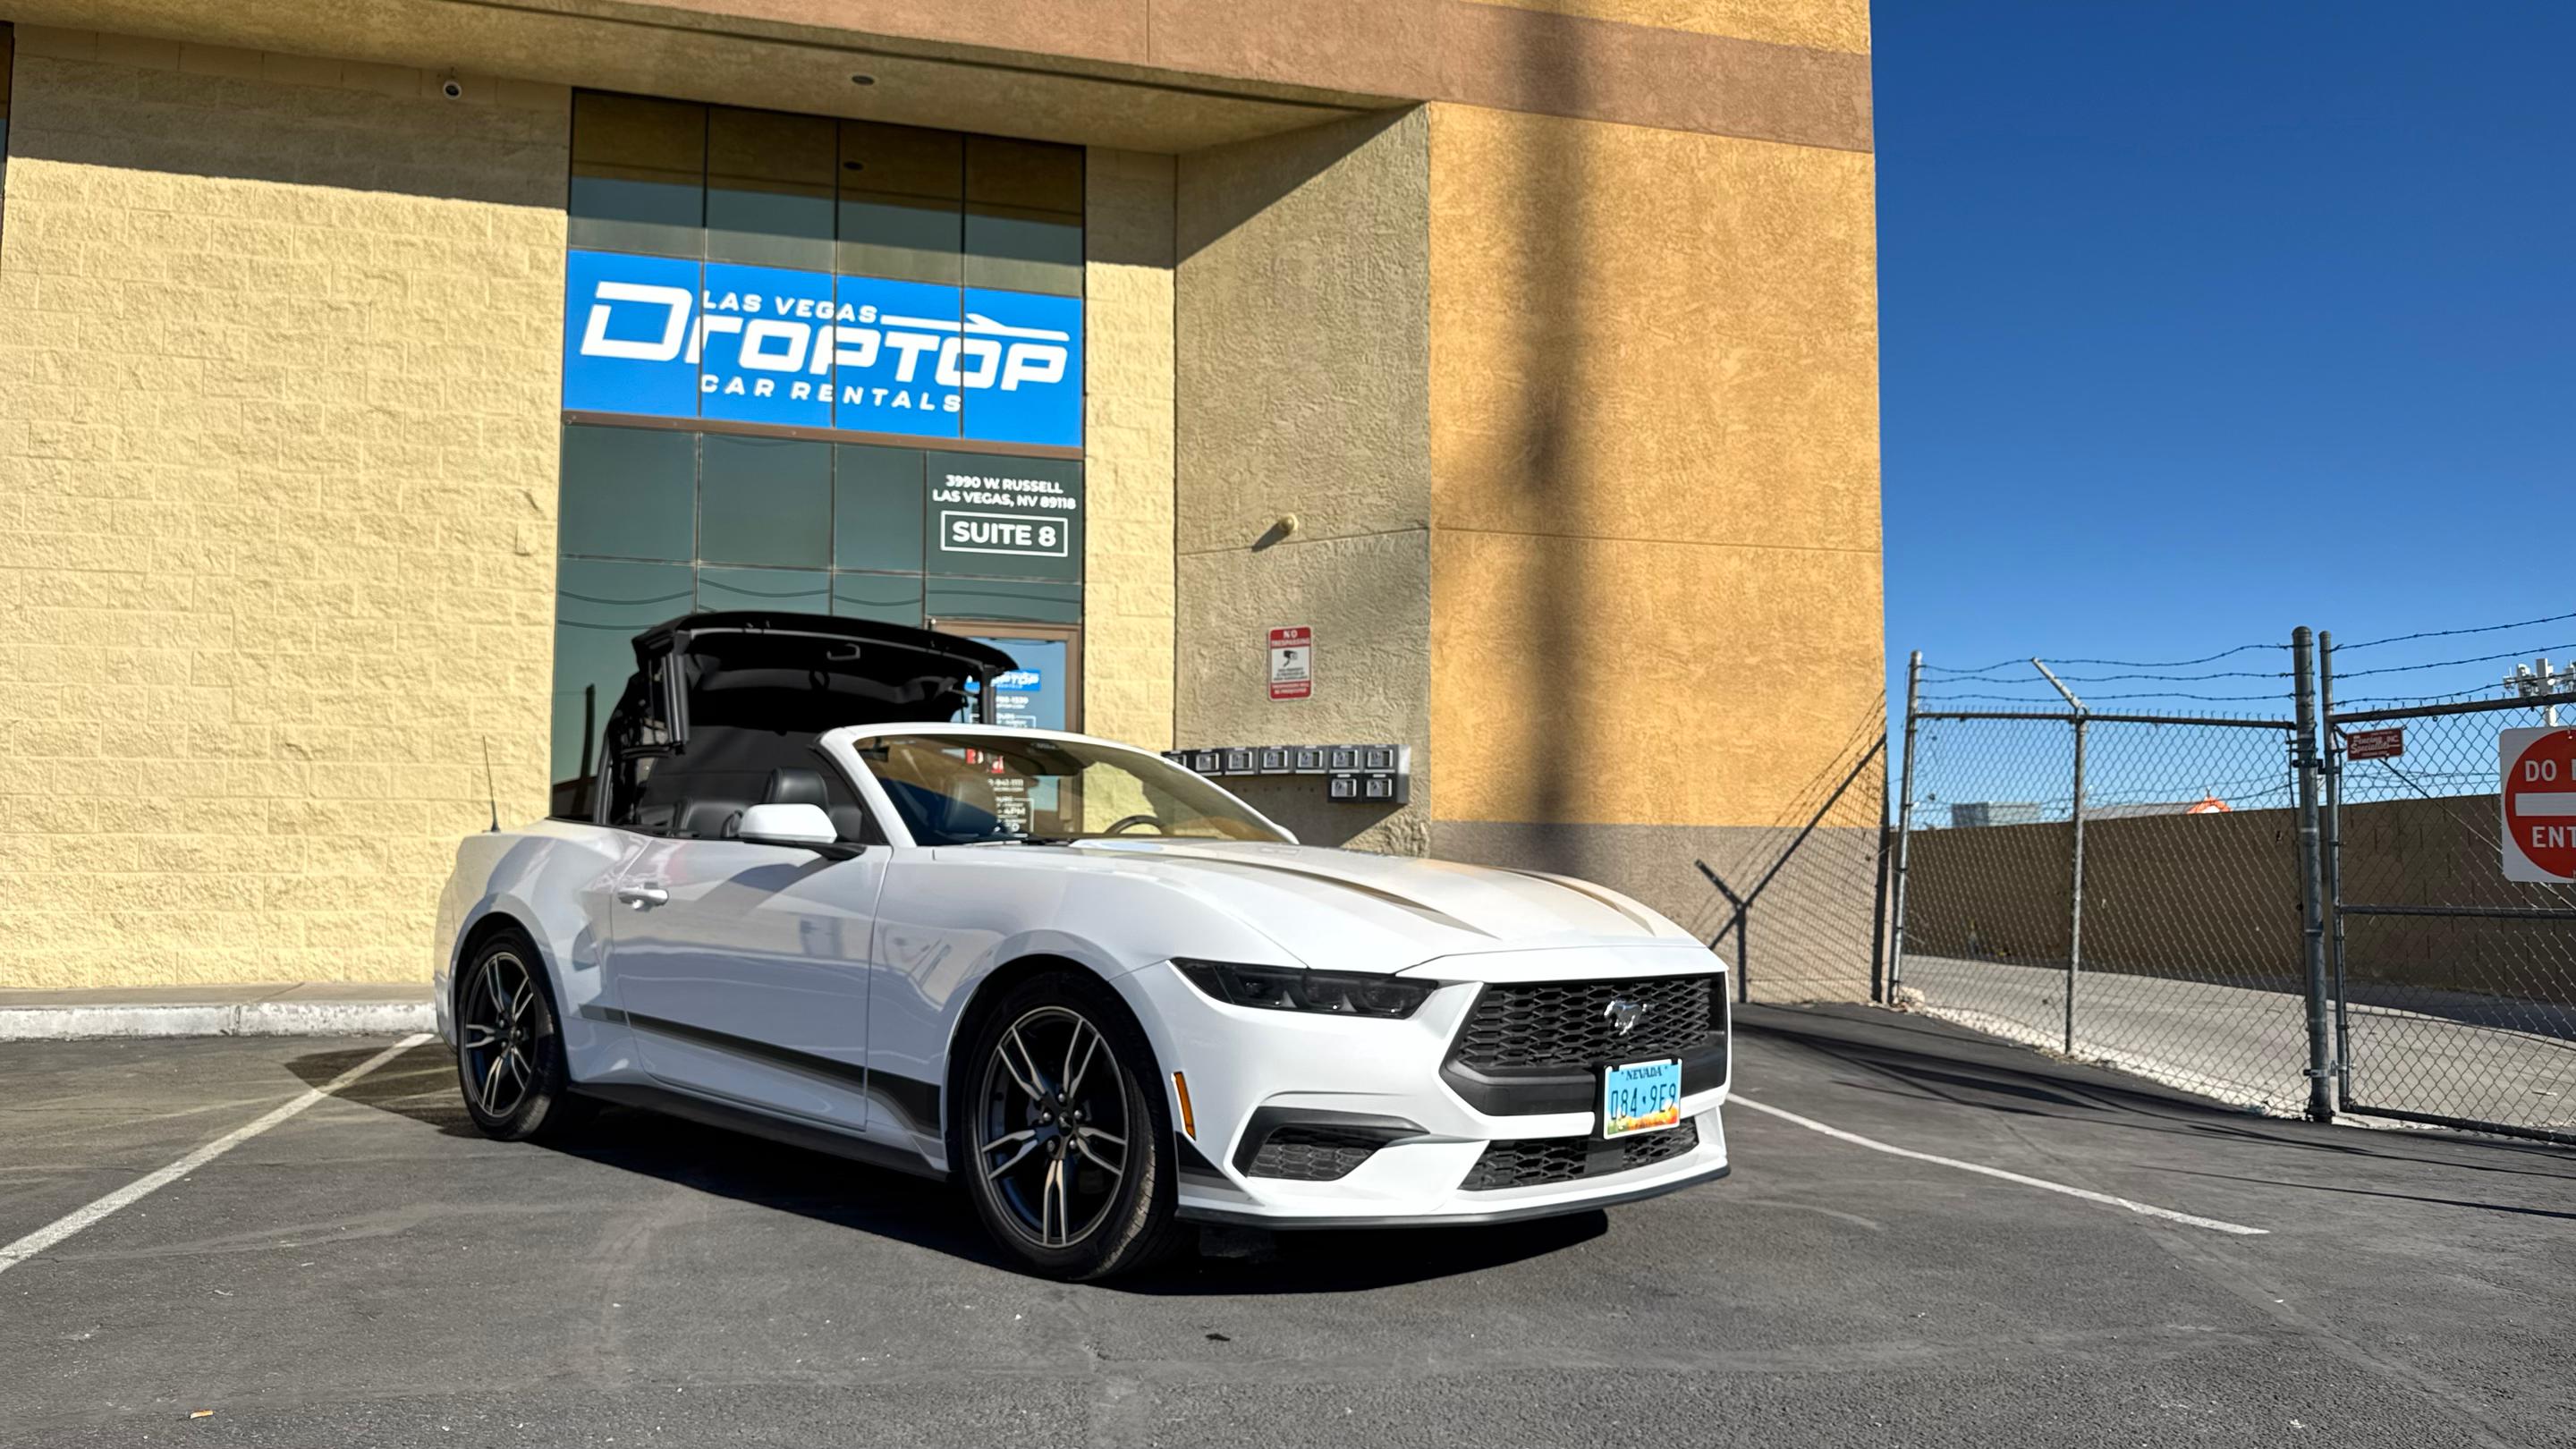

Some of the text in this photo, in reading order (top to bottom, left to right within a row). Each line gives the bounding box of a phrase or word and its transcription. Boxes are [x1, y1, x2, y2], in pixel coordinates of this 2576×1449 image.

[703, 291, 878, 324] LAS VEGAS
[701, 376, 962, 413] CAR RENTALS
[945, 474, 981, 488] 3990
[1003, 479, 1063, 494] RUSSELL
[932, 489, 1076, 510] LAS VEGAS, NV 89118
[952, 521, 1056, 547] SUITE 8
[1283, 629, 1298, 640] NO
[2525, 759, 2557, 782] DO
[2532, 826, 2576, 848] ENT
[1626, 1066, 1662, 1081] NEVADA
